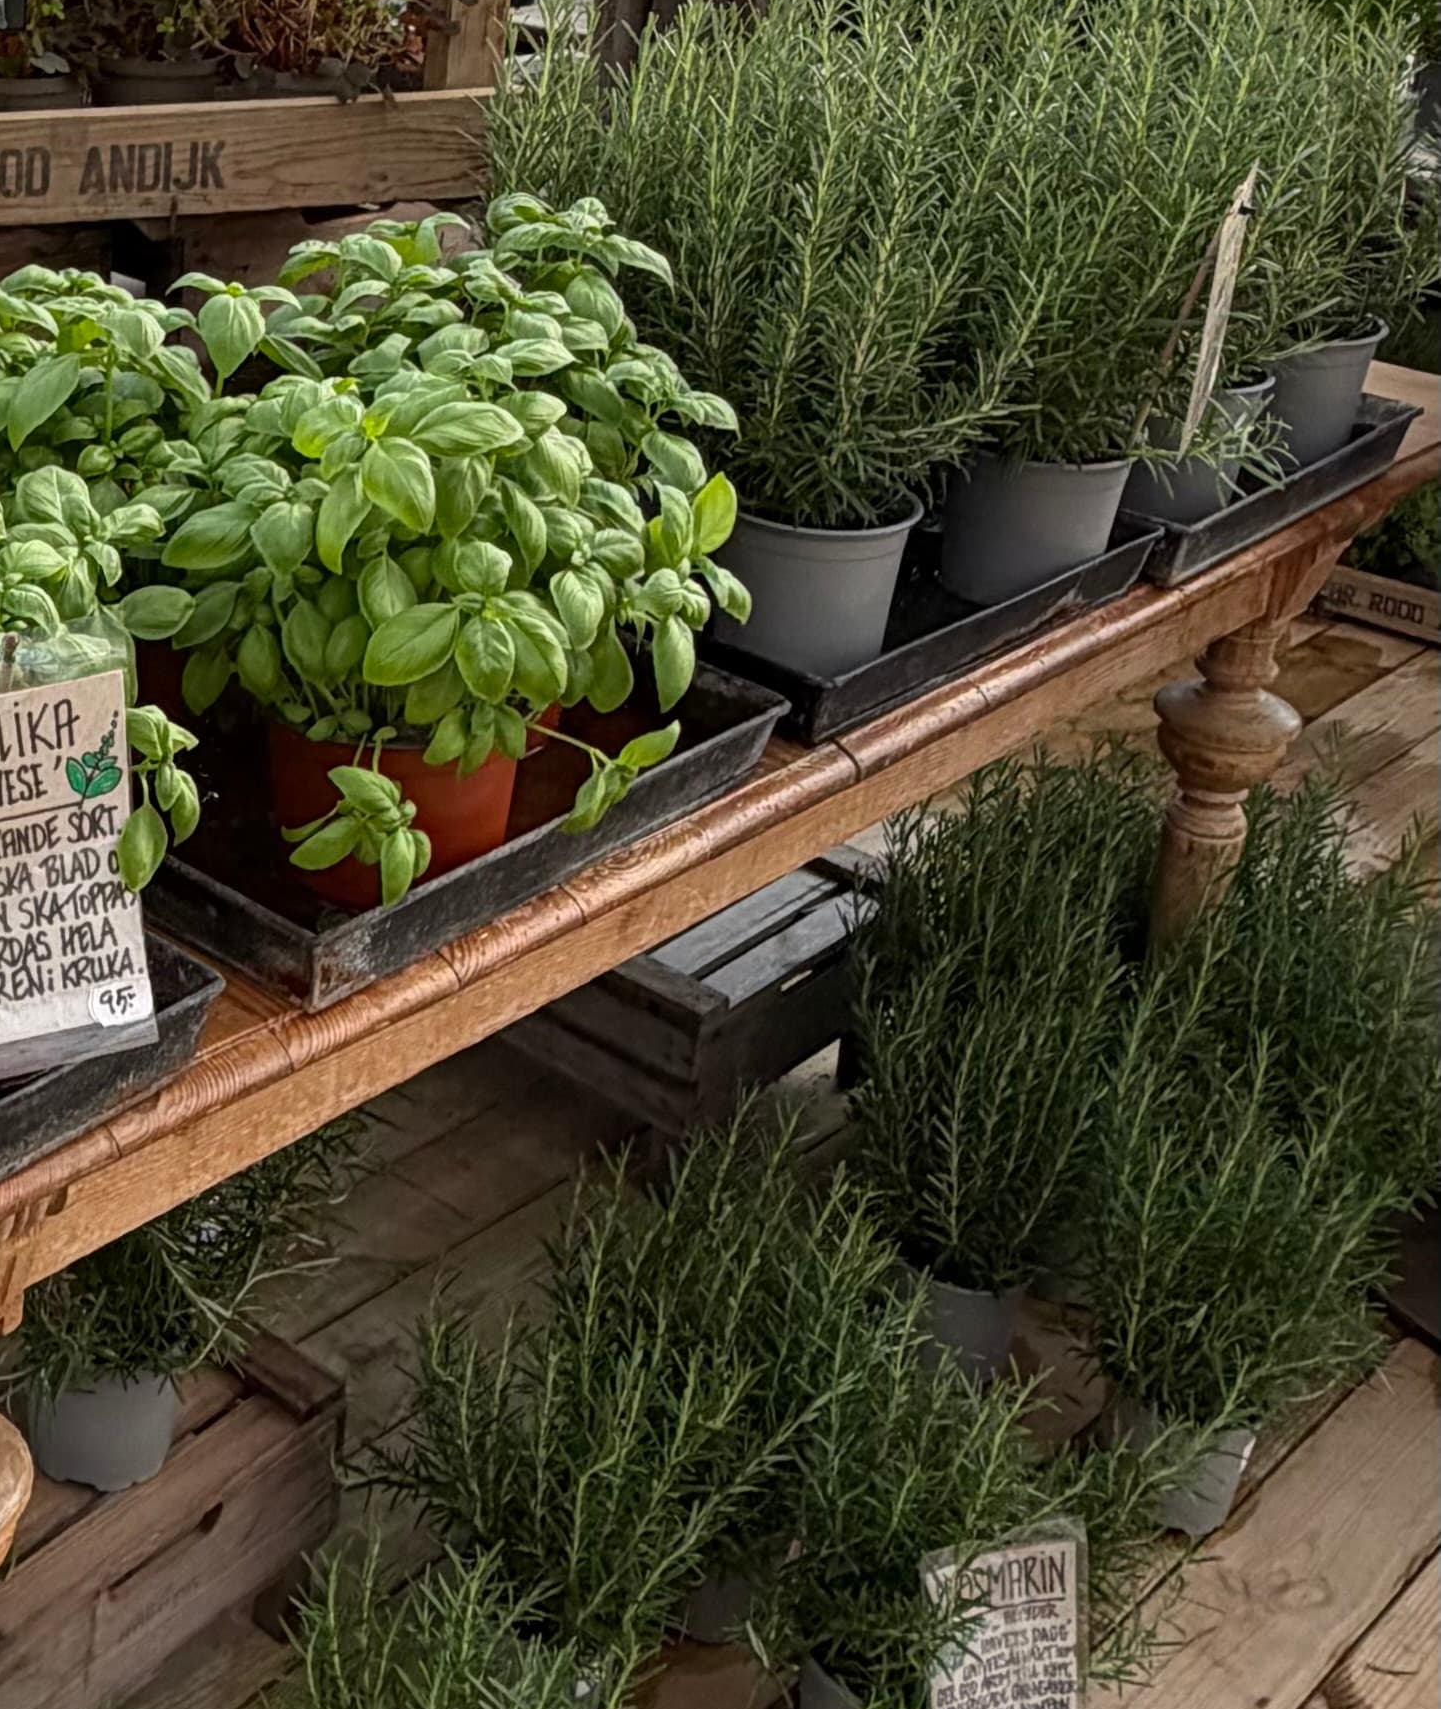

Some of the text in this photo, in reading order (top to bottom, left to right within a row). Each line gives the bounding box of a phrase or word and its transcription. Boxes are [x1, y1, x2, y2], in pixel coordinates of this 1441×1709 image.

[78, 138, 228, 196] ANDIJK
[66, 803, 122, 843] SORT.
[39, 846, 100, 889] BLAD
[17, 889, 66, 930] SKA
[60, 916, 119, 958] HELA
[60, 946, 145, 990] KRUKA.
